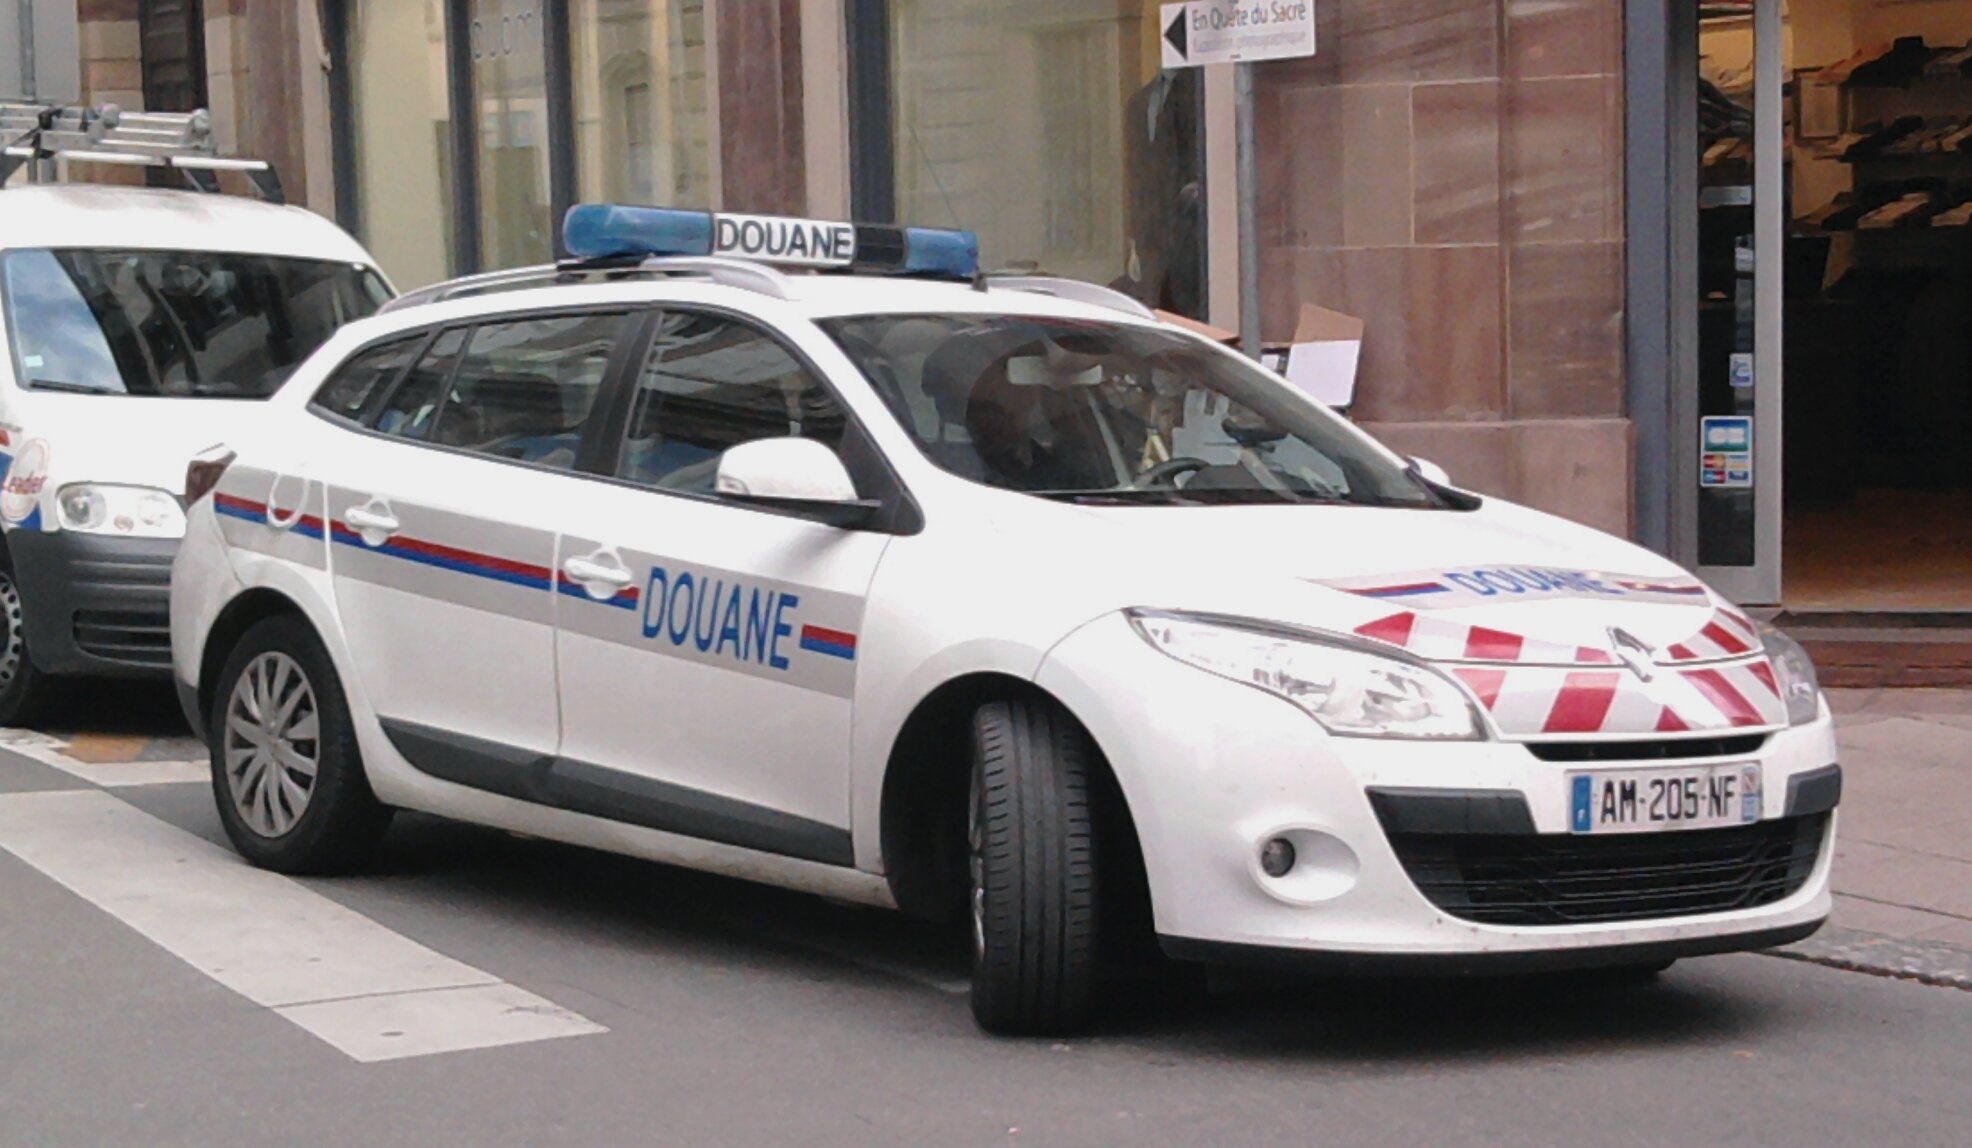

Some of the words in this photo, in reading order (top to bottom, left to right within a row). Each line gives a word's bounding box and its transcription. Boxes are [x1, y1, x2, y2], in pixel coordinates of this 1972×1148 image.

[1192, 9, 1208, 31] En
[1251, 4, 1268, 24] du
[717, 218, 851, 259] DOUANE
[1442, 567, 1626, 596] DOUANE
[642, 566, 799, 670] DOUANE
[1600, 775, 1737, 824] AM-205-NF
